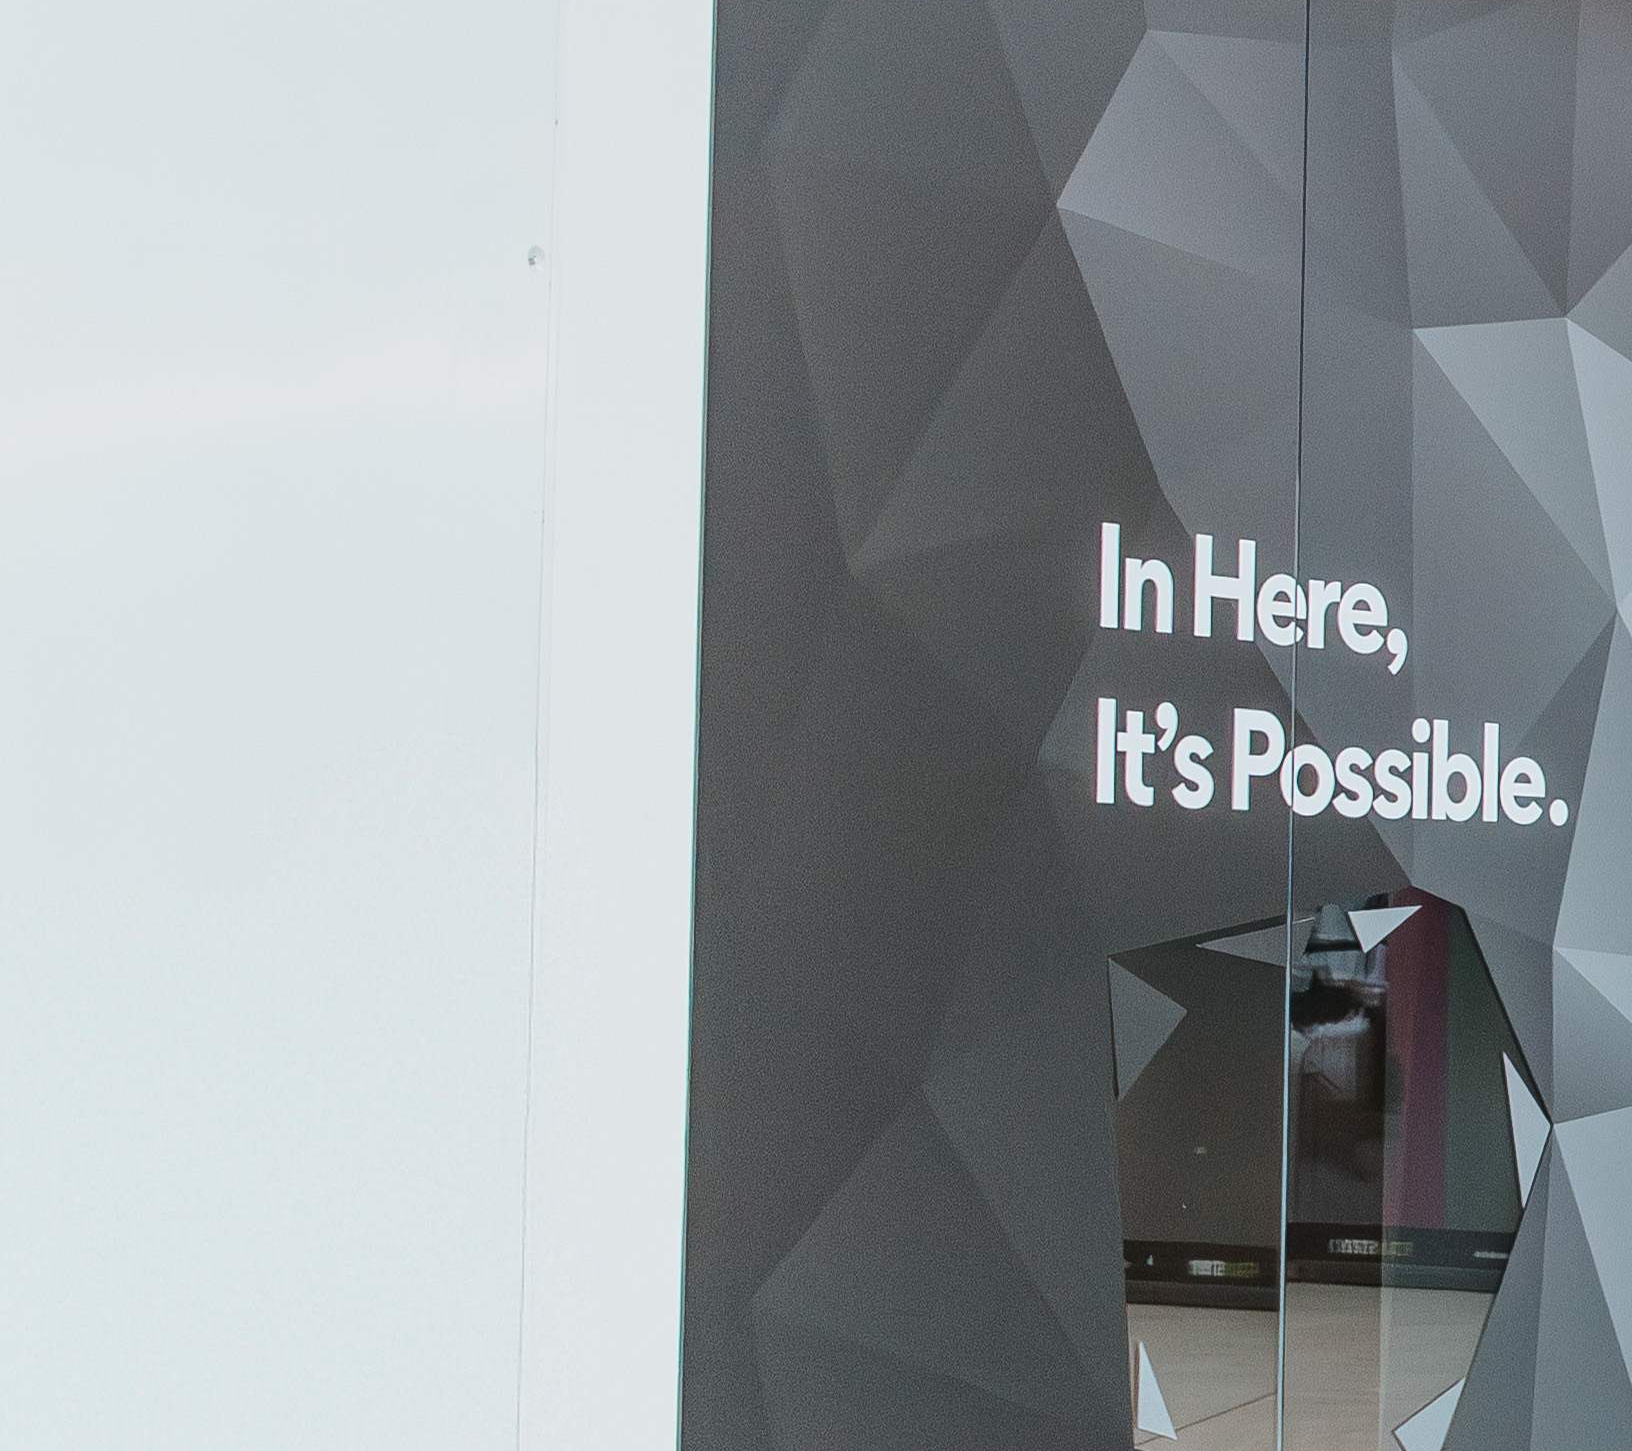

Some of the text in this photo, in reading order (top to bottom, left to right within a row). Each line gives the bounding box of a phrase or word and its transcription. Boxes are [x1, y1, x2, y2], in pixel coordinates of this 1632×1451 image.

[1100, 522, 1409, 675] In Here,
[1096, 697, 1569, 826] It’s Possible.
